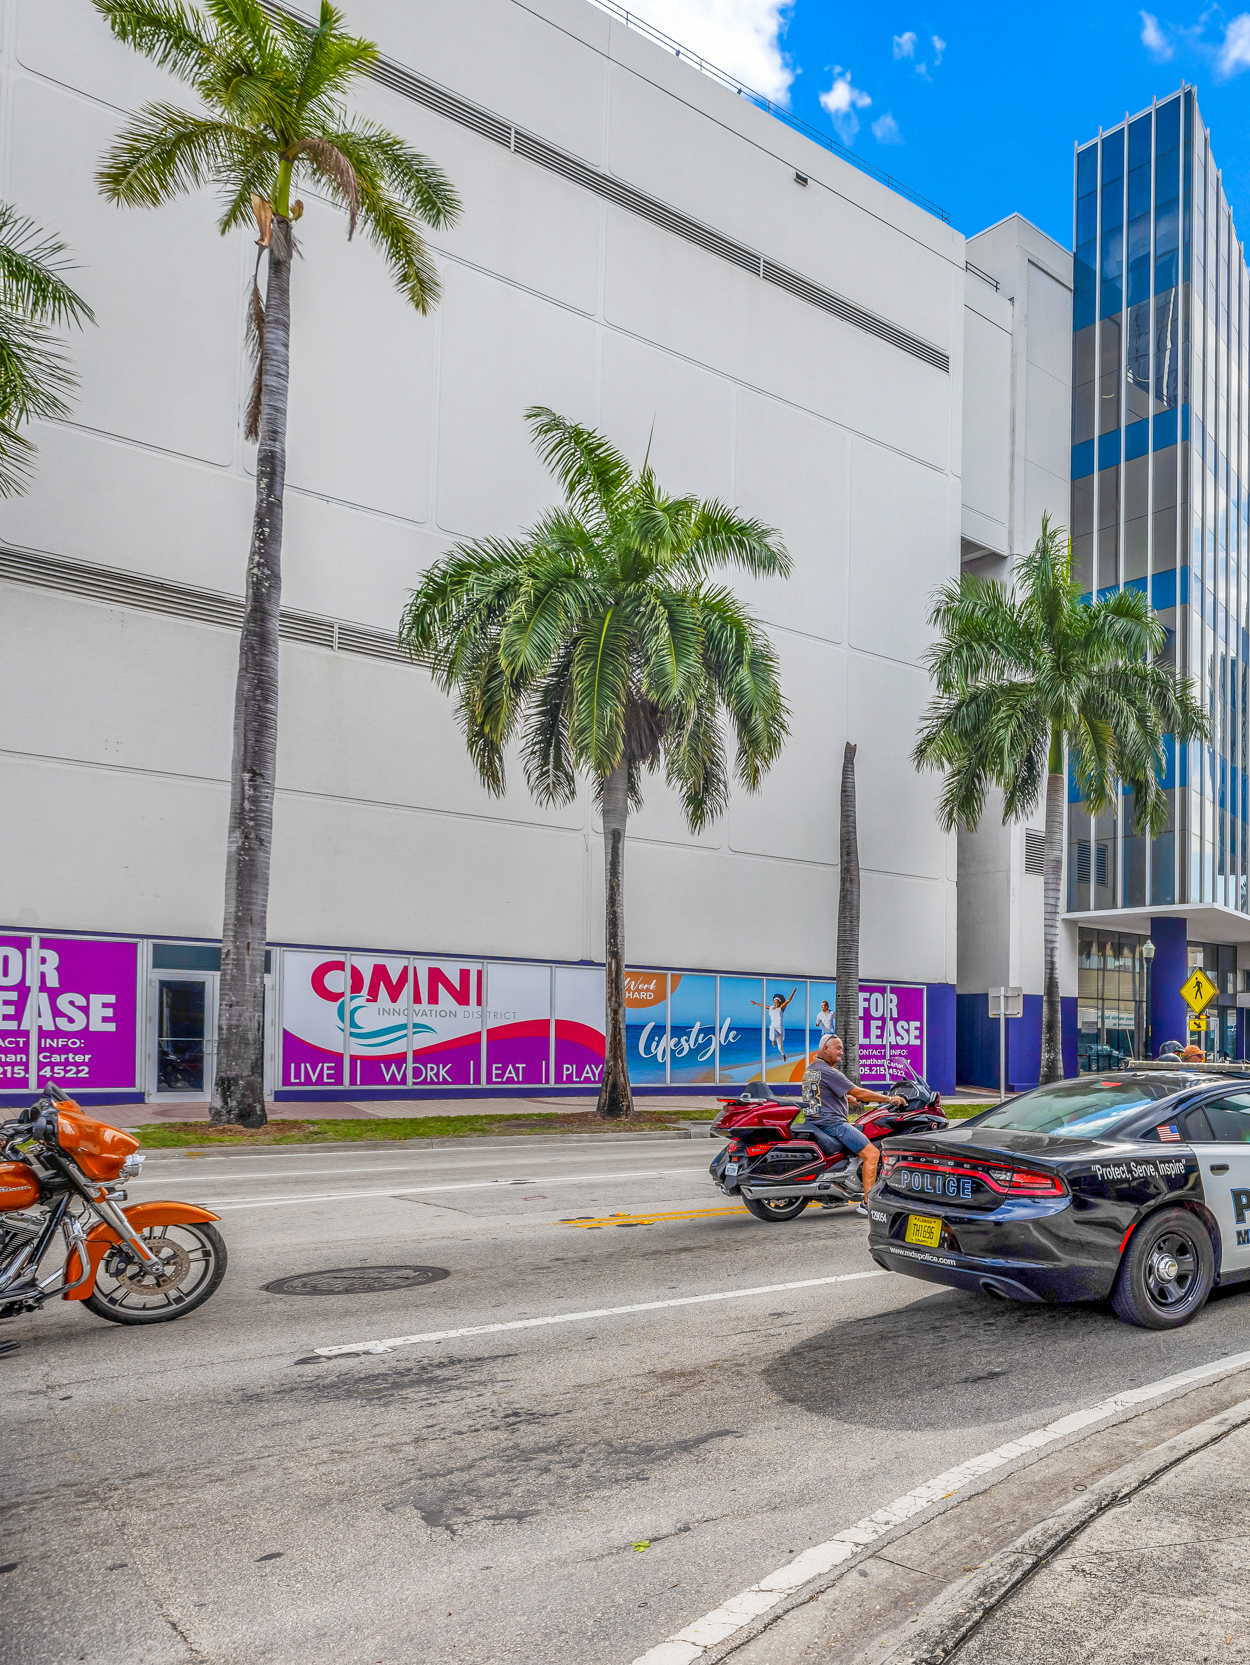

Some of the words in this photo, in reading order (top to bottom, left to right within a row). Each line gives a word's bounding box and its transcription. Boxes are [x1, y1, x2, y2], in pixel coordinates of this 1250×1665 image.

[311, 960, 488, 1006] OMNI
[624, 977, 658, 991] Work
[626, 991, 654, 1000] HARD
[378, 1007, 457, 1018] INNOVATION
[859, 992, 898, 1018] FOR
[463, 1010, 518, 1020] DISTRICT
[638, 1016, 742, 1064] Lifestyle
[858, 1020, 921, 1045] LEASE
[41, 1038, 84, 1048] INFO:
[38, 1052, 92, 1062] Carter
[290, 1063, 335, 1082] LIVE
[380, 1063, 452, 1082] WORK
[492, 1064, 526, 1082] EAT
[562, 1064, 602, 1081] PLAY
[907, 1156, 970, 1168] DODGE
[901, 1170, 972, 1199] POLICE
[890, 1246, 956, 1266] www.mdspolice.com
